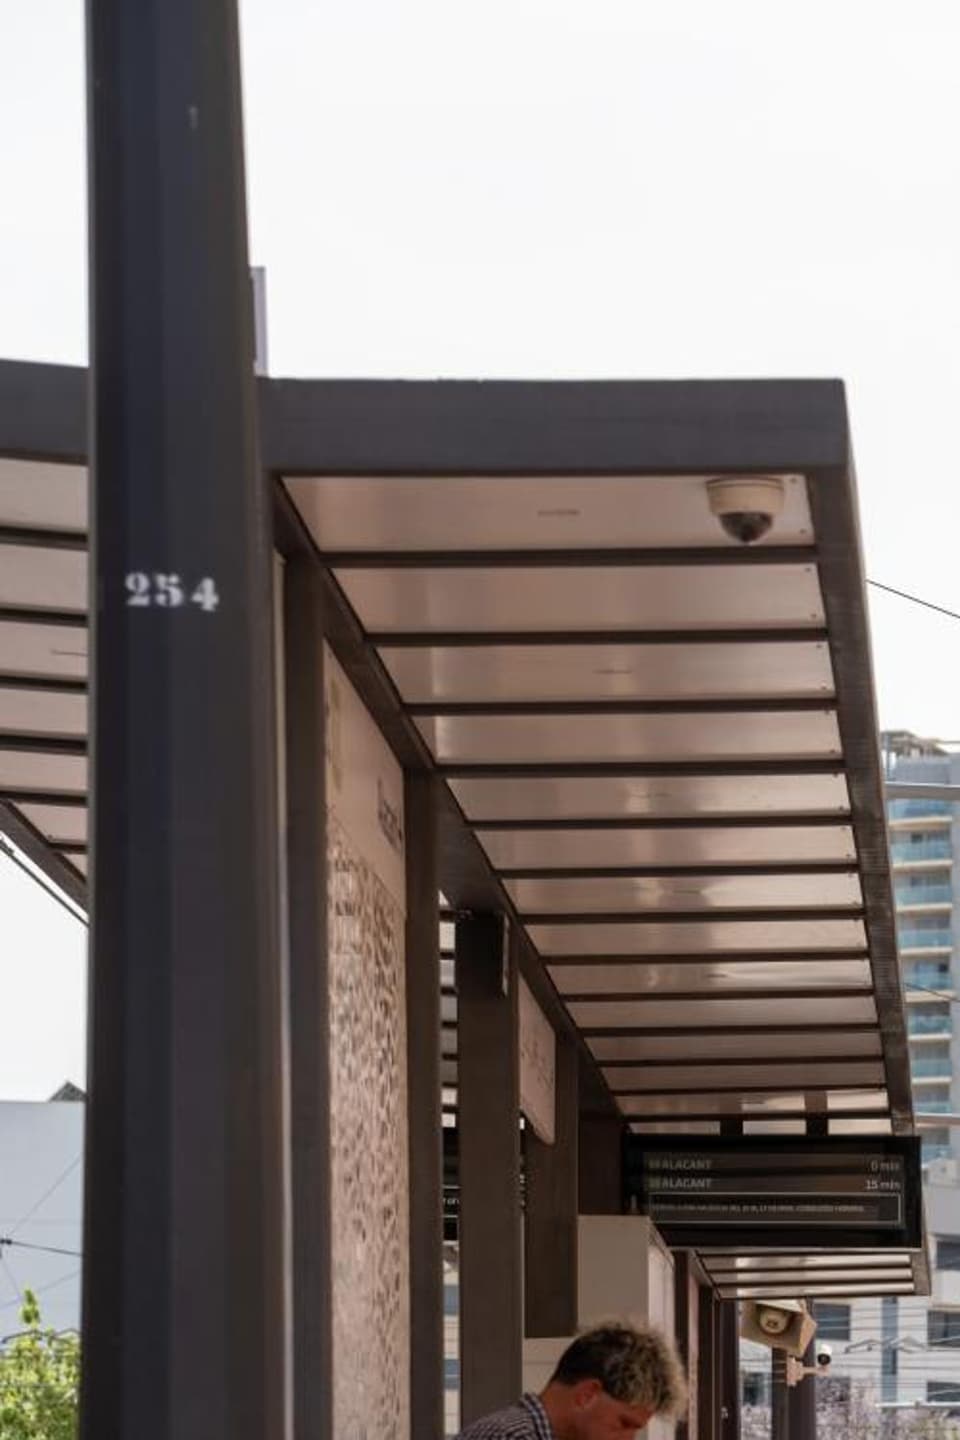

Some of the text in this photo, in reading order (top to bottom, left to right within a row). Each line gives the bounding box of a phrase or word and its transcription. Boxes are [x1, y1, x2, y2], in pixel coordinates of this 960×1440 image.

[124, 572, 220, 612] 254
[662, 1178, 713, 1189] ALACANT
[866, 1179, 902, 1189] 15 min
